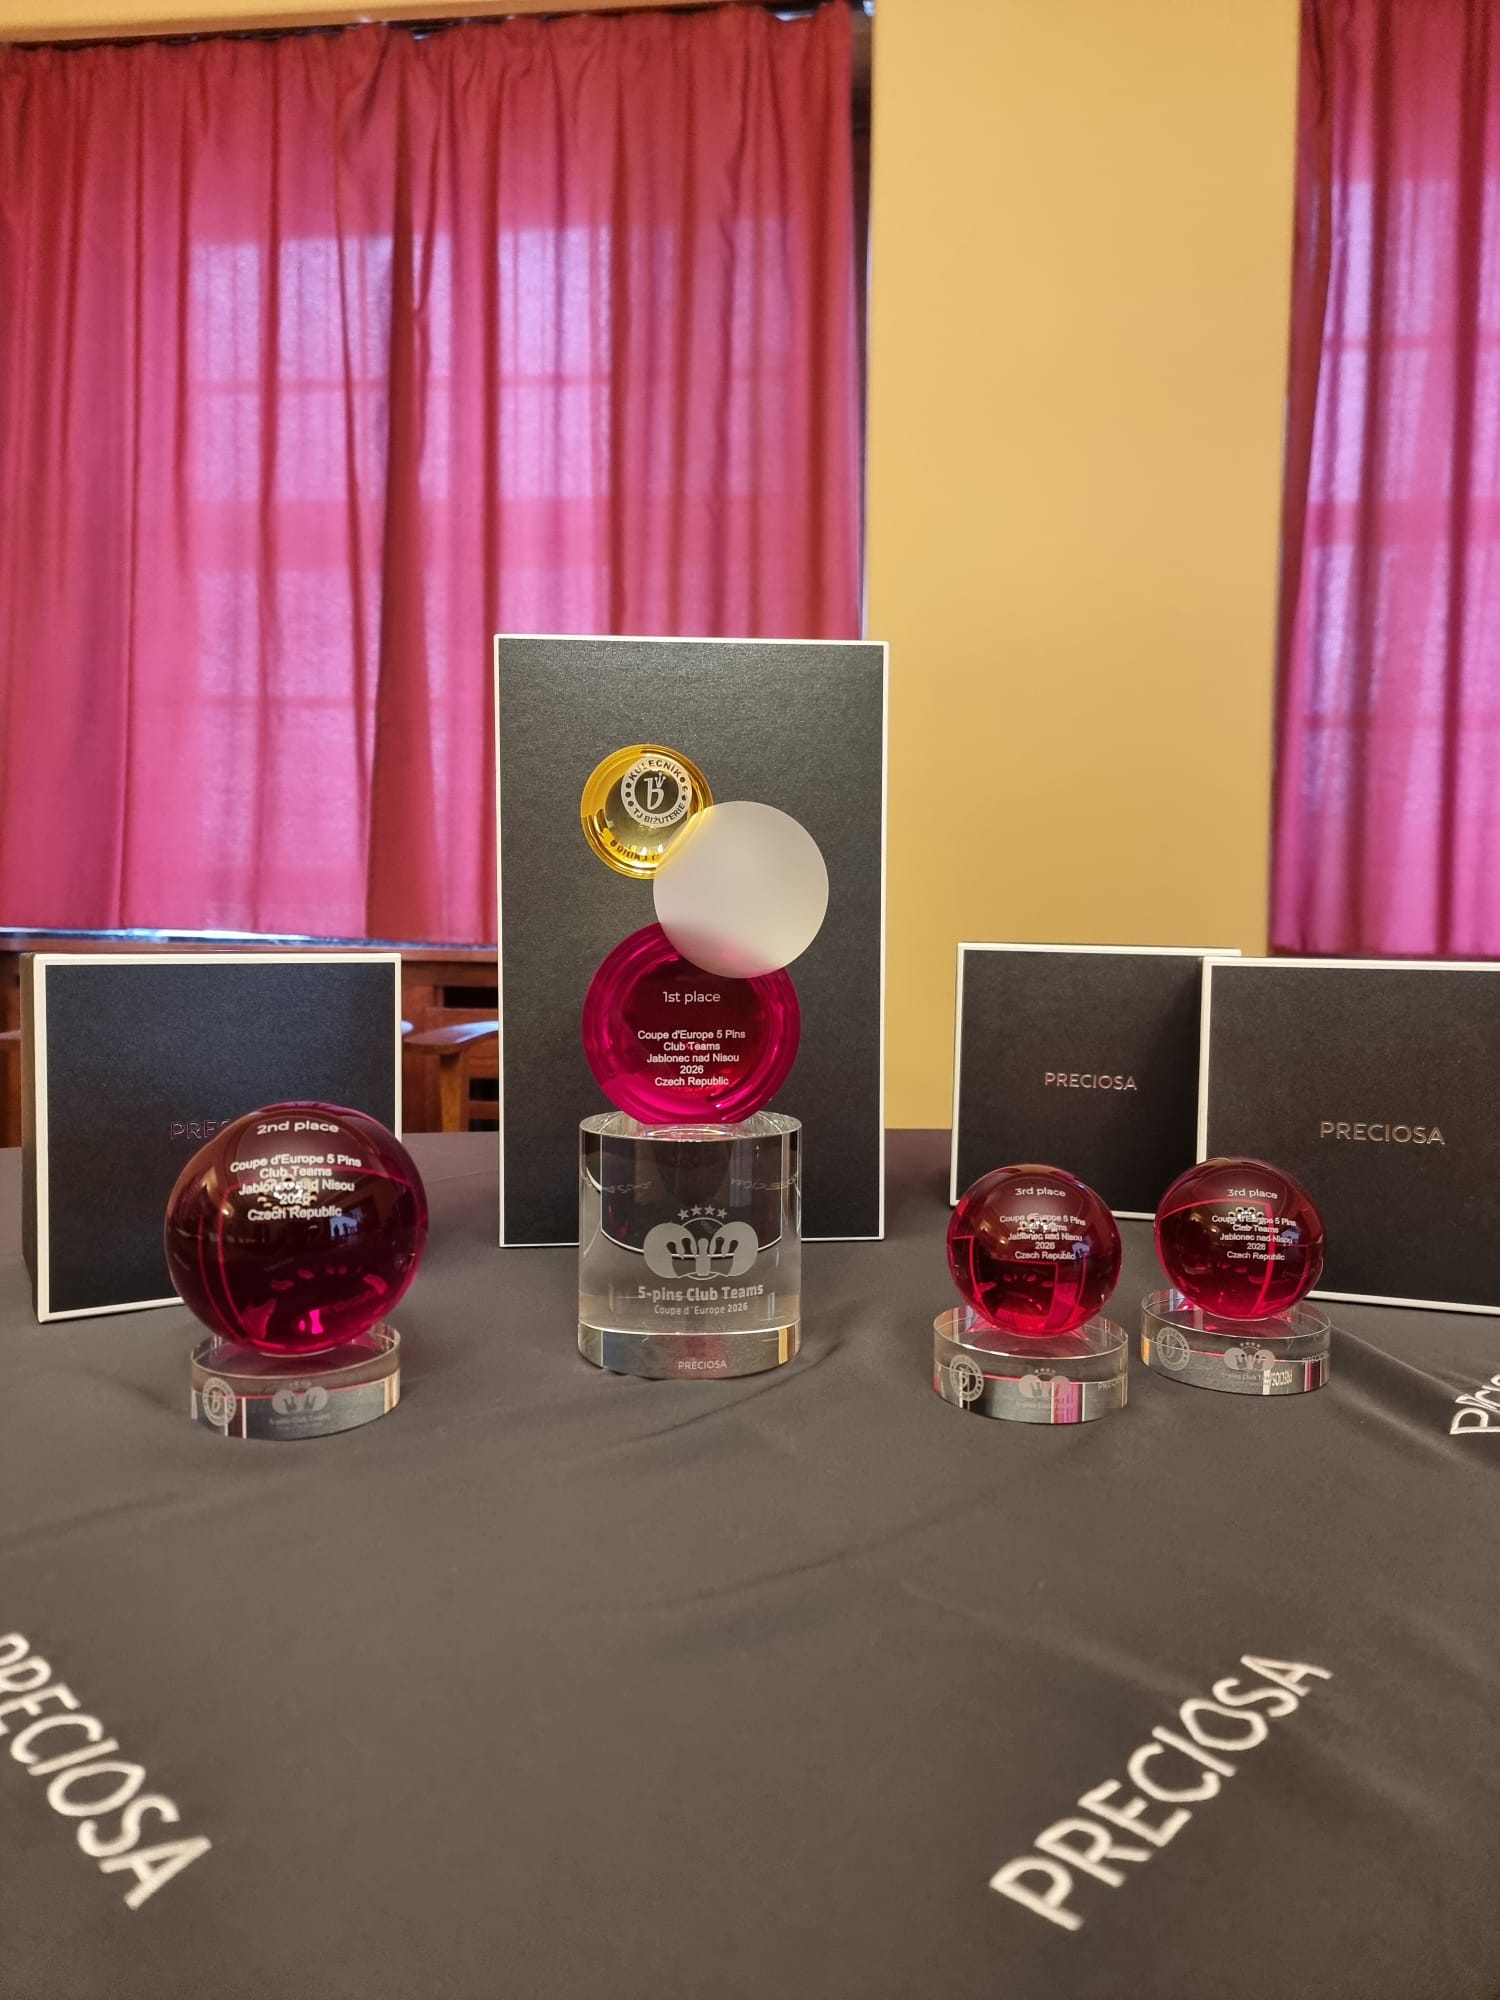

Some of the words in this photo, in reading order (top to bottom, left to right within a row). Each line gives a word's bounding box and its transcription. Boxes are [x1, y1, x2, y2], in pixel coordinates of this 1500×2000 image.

[662, 991, 681, 1003] 1st
[684, 990, 721, 1005] place
[637, 1030, 669, 1041] Coupe
[671, 1029, 714, 1041] d'Europe
[716, 1029, 723, 1039] 5
[725, 1029, 746, 1039] Pins
[663, 1041, 686, 1051] Club
[687, 1041, 721, 1051] Teams
[646, 1053, 690, 1063] Jablonec
[692, 1053, 710, 1063] nad
[712, 1052, 740, 1062] Nisou
[679, 1065, 704, 1075] 2026
[654, 1076, 685, 1087] Czech
[687, 1076, 730, 1088] Republic
[1044, 1072, 1138, 1091] PRECIOSA
[256, 1121, 290, 1135] 2nd
[294, 1120, 340, 1133] place
[1319, 1120, 1446, 1145] PRECIOSA
[230, 1158, 268, 1173] Coupe
[270, 1153, 325, 1166] d'Europe
[326, 1154, 336, 1165] 5
[337, 1154, 362, 1167] Pins
[259, 1167, 289, 1179] Club
[290, 1166, 333, 1177] Teams
[321, 1180, 355, 1192] Nisou
[1015, 1187, 1034, 1196] 3rd
[1036, 1187, 1067, 1197] place
[1227, 1188, 1246, 1197] 3rd
[1248, 1188, 1279, 1199] place
[247, 1207, 287, 1222] Czech
[289, 1205, 343, 1219] Republic
[1063, 1214, 1070, 1222] 5
[1274, 1217, 1281, 1225] 5
[1219, 1233, 1255, 1241] Jablonec
[1256, 1233, 1271, 1242] nad
[1014, 1251, 1040, 1260] Czech
[1041, 1251, 1077, 1261] Republic
[1226, 1251, 1251, 1260] Czech
[1252, 1252, 1286, 1262] Republic
[637, 1286, 684, 1302] 5-pins
[686, 1287, 719, 1301] Club
[720, 1283, 764, 1300] Teams
[654, 1305, 682, 1316] Coupe
[727, 1302, 748, 1313] 2026
[678, 1359, 727, 1370] PRECIOSA
[990, 1654, 1333, 1932] PRECIOSA
